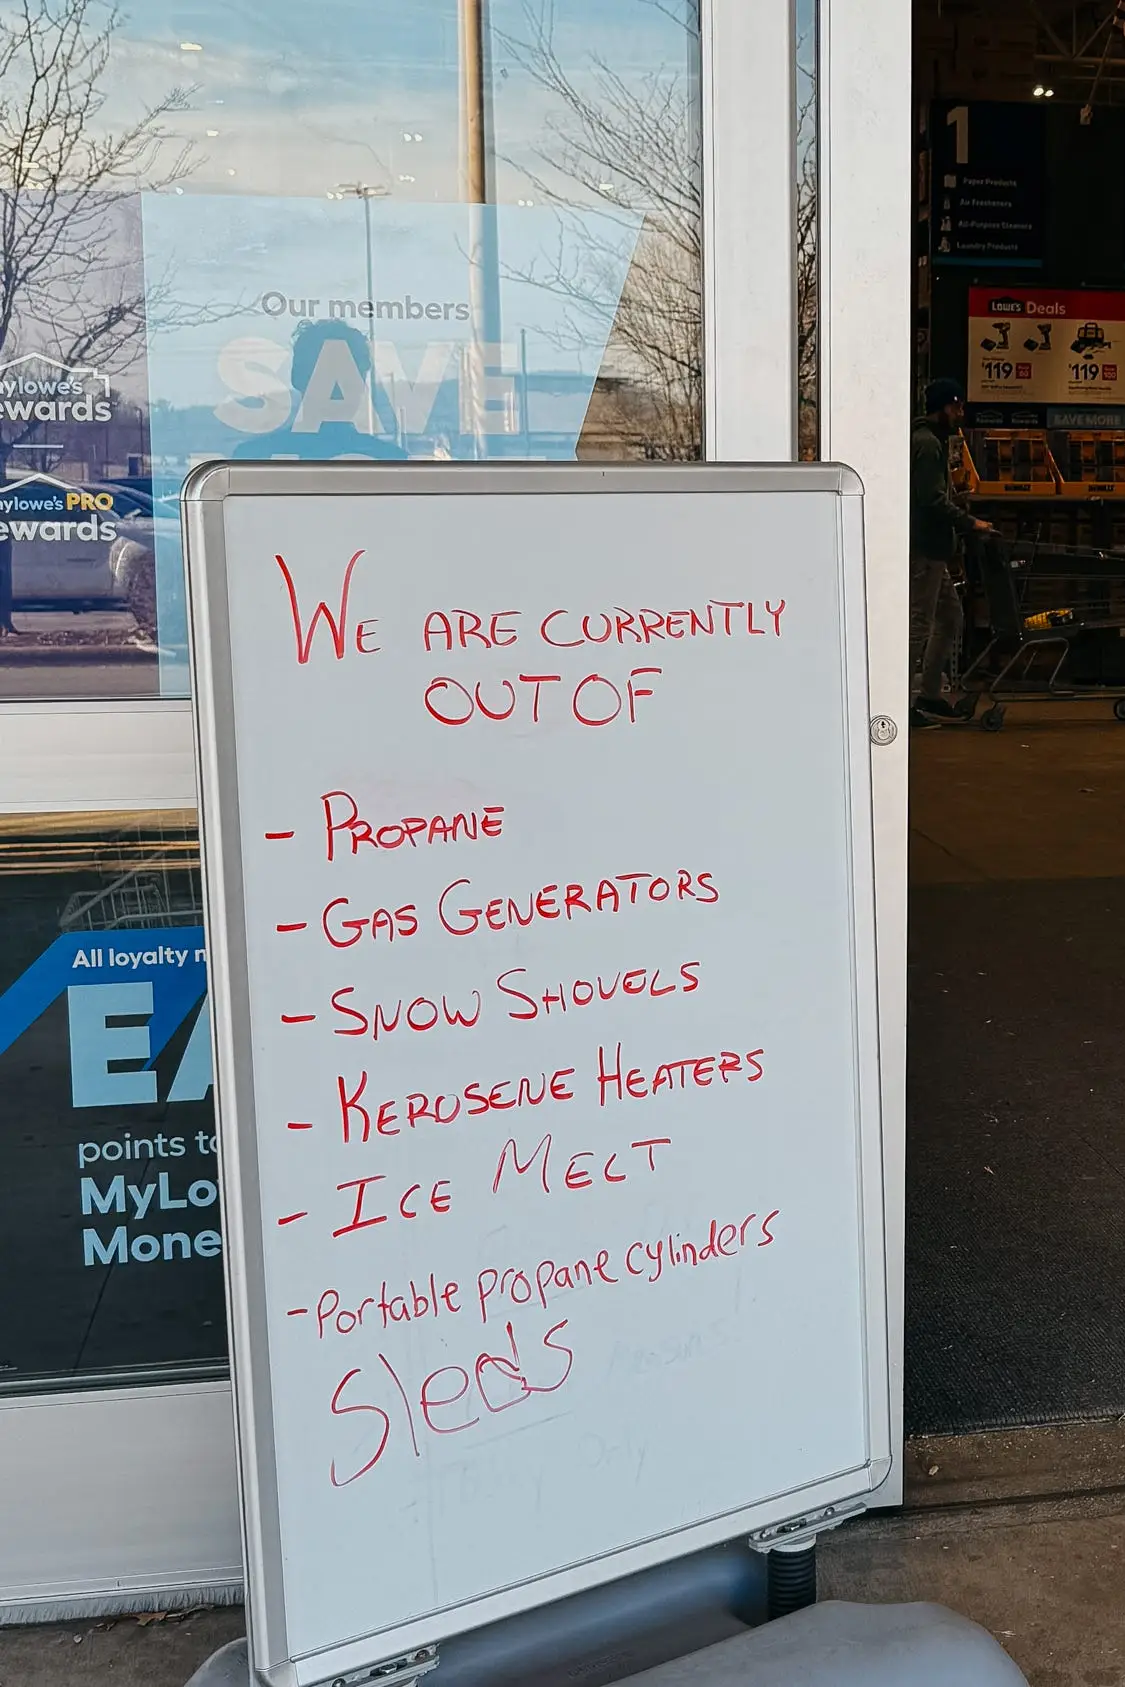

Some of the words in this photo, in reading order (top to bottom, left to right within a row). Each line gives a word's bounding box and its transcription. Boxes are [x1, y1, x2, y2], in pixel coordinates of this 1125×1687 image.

[946, 105, 969, 165] 1
[956, 241, 985, 251] Laundry
[261, 291, 321, 318] Our
[328, 293, 471, 321] members
[1026, 300, 1067, 316] Deals
[0, 394, 113, 422] wards
[214, 336, 519, 434] SAVE
[66, 492, 114, 511] PRO
[273, 549, 382, 665] WE
[422, 609, 522, 652] ARE
[540, 599, 786, 648] CURRENTLY
[424, 674, 562, 727] OUT
[572, 667, 662, 728] OF
[320, 790, 506, 863] PROPANE
[320, 897, 420, 949] GAS
[437, 868, 722, 938] GENERATORS
[72, 948, 103, 968] All
[109, 946, 188, 970] loyalty
[330, 986, 483, 1041] SNOW
[495, 961, 702, 1022] SHOVELS
[336, 1067, 576, 1145] KEROSENE
[596, 1042, 766, 1107] HEATERS
[78, 1132, 187, 1169] points
[80, 1171, 218, 1220] MyLo
[331, 1175, 452, 1239] ICE
[491, 1132, 673, 1195] MELT
[82, 1225, 222, 1267] Mone
[477, 1249, 620, 1326] propane
[625, 1209, 782, 1284] cylinders
[329, 1318, 575, 1489] Sleds
